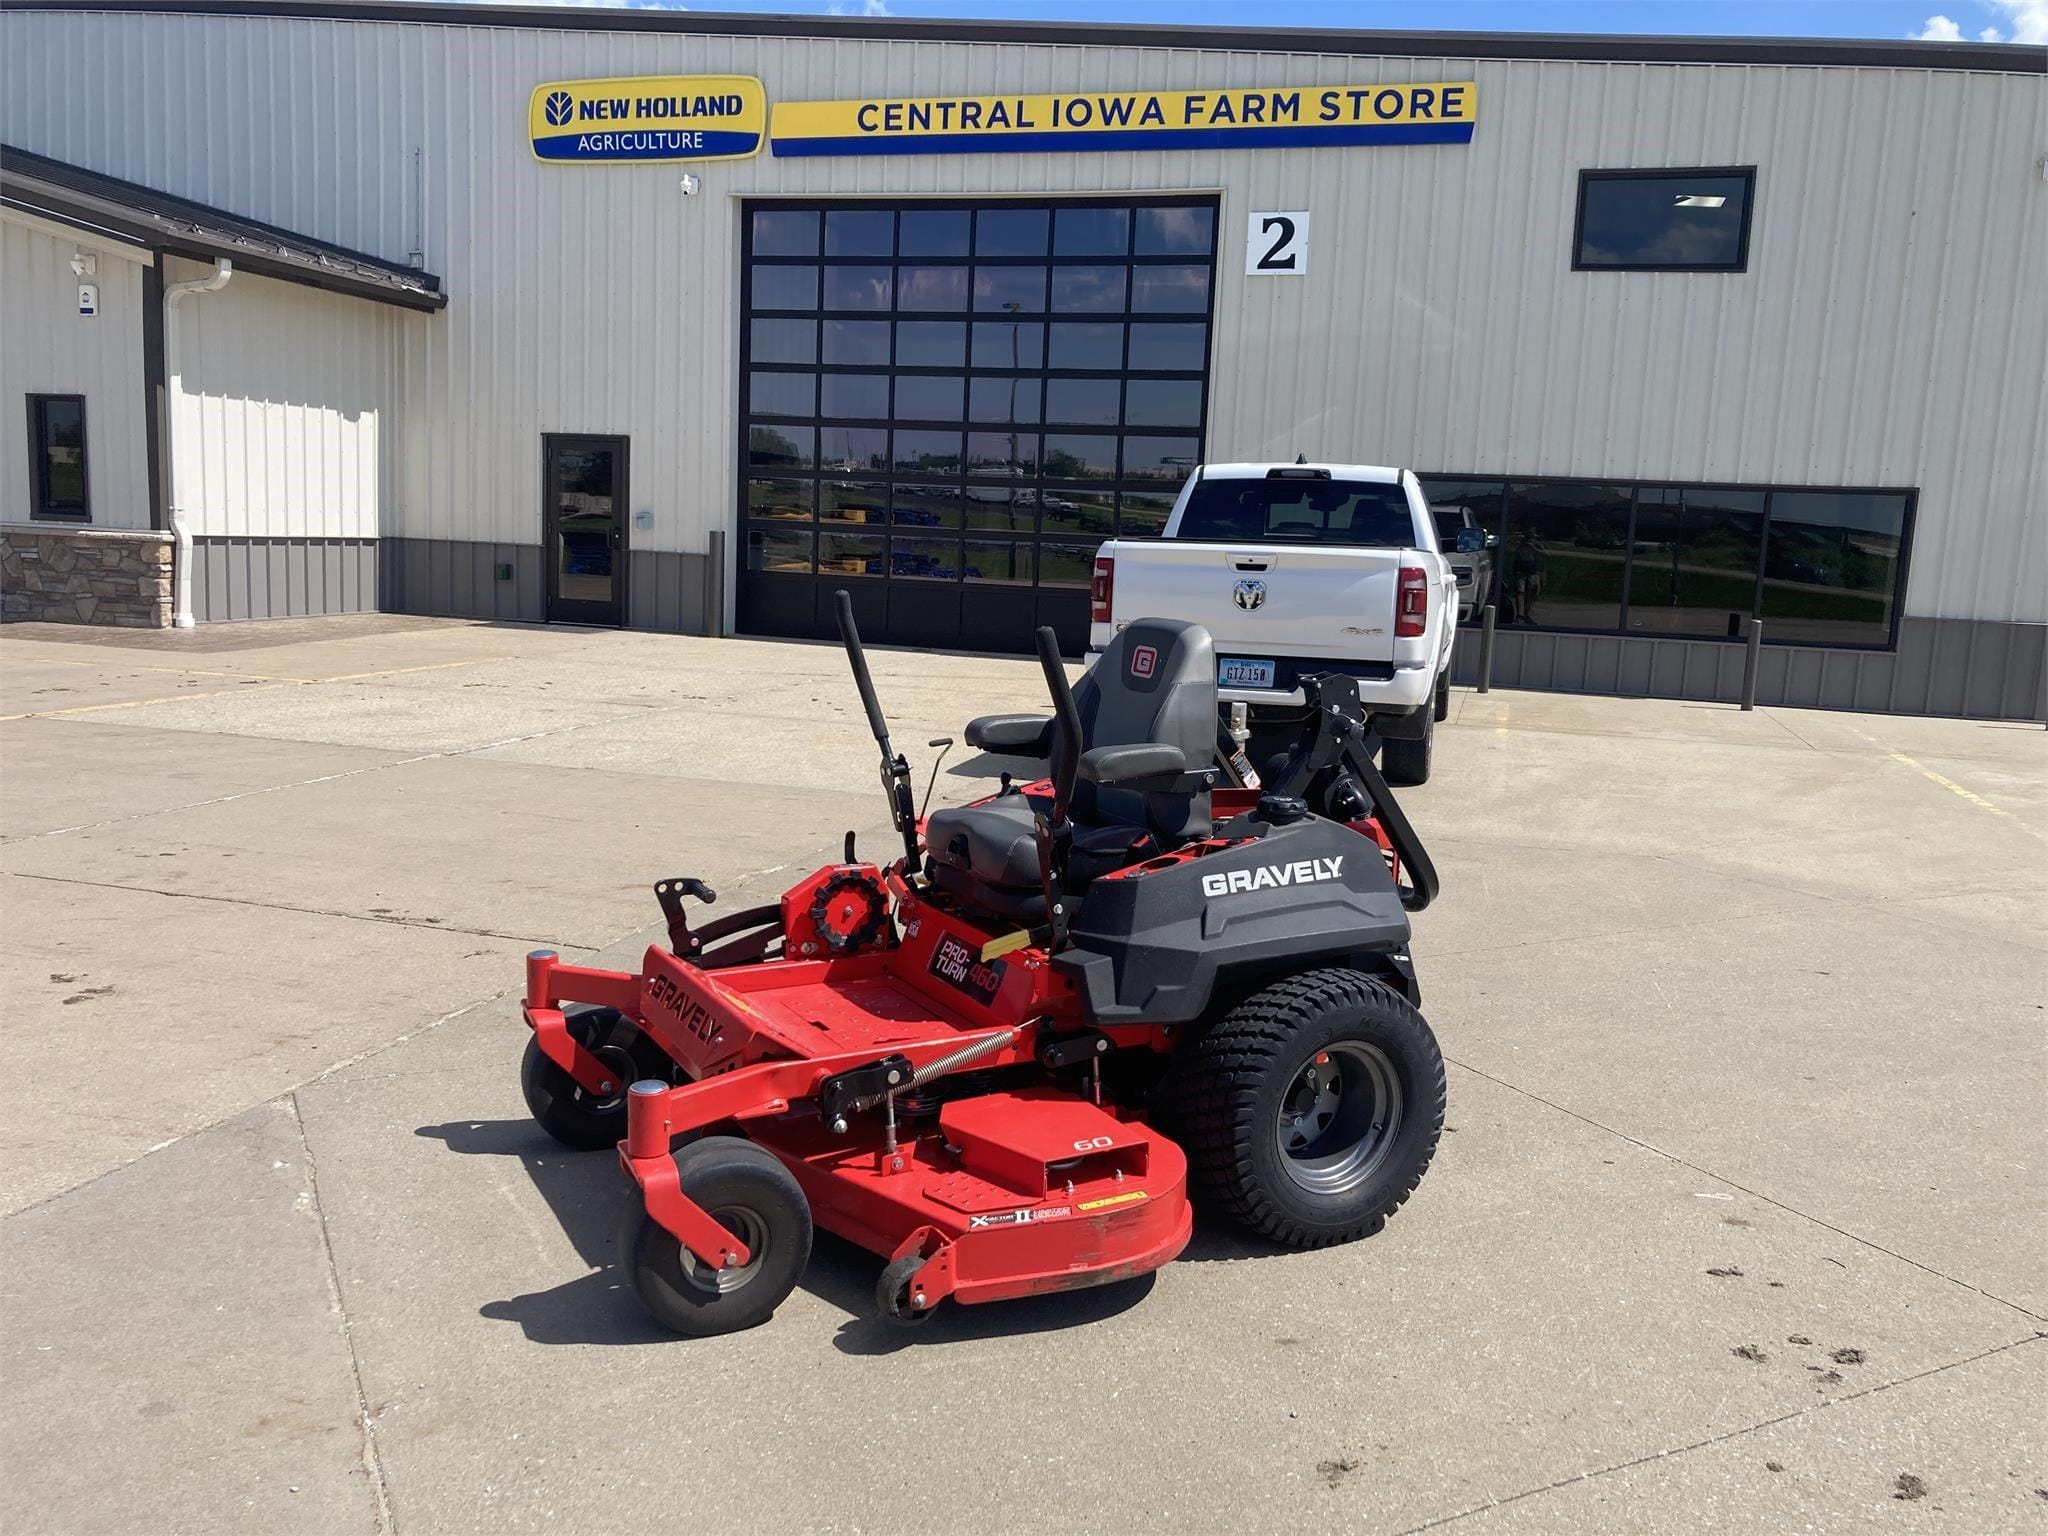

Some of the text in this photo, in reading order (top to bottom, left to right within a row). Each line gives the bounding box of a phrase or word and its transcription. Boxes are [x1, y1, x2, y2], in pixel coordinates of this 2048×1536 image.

[579, 95, 743, 120] NEW HOLLAND
[857, 87, 1465, 132] CENTRAL IOWA FARM STORE
[578, 132, 703, 151] AGRICULTURE
[1257, 216, 1297, 270] 2
[1226, 666, 1245, 680] GTZ
[1202, 856, 1344, 897] GRAVELY
[941, 940, 970, 964] PRO-
[936, 954, 968, 982] TURN
[969, 963, 999, 992] 460
[651, 974, 723, 1045] GRAVELY
[1073, 1136, 1113, 1151] 60
